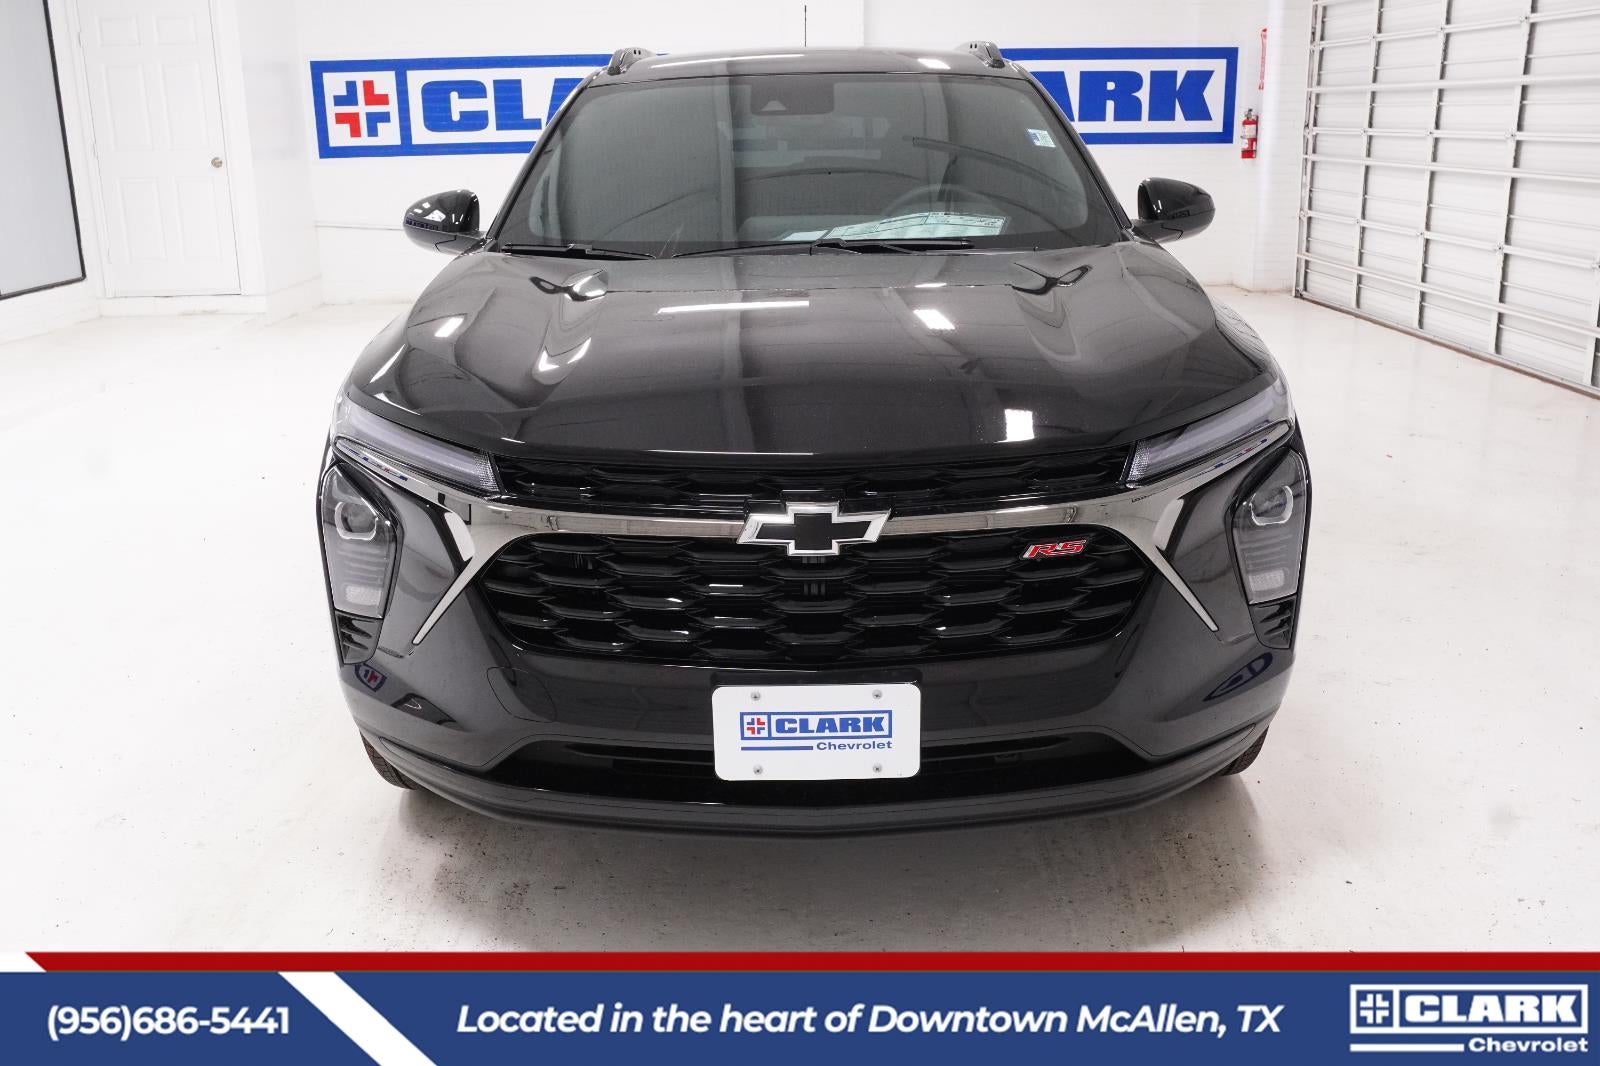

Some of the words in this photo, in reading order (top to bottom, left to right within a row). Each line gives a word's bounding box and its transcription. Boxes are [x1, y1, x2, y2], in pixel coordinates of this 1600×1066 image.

[421, 78, 584, 133] CL
[1022, 539, 1087, 559] RS
[775, 716, 885, 734] CLARK
[816, 740, 893, 751] Chevrolet
